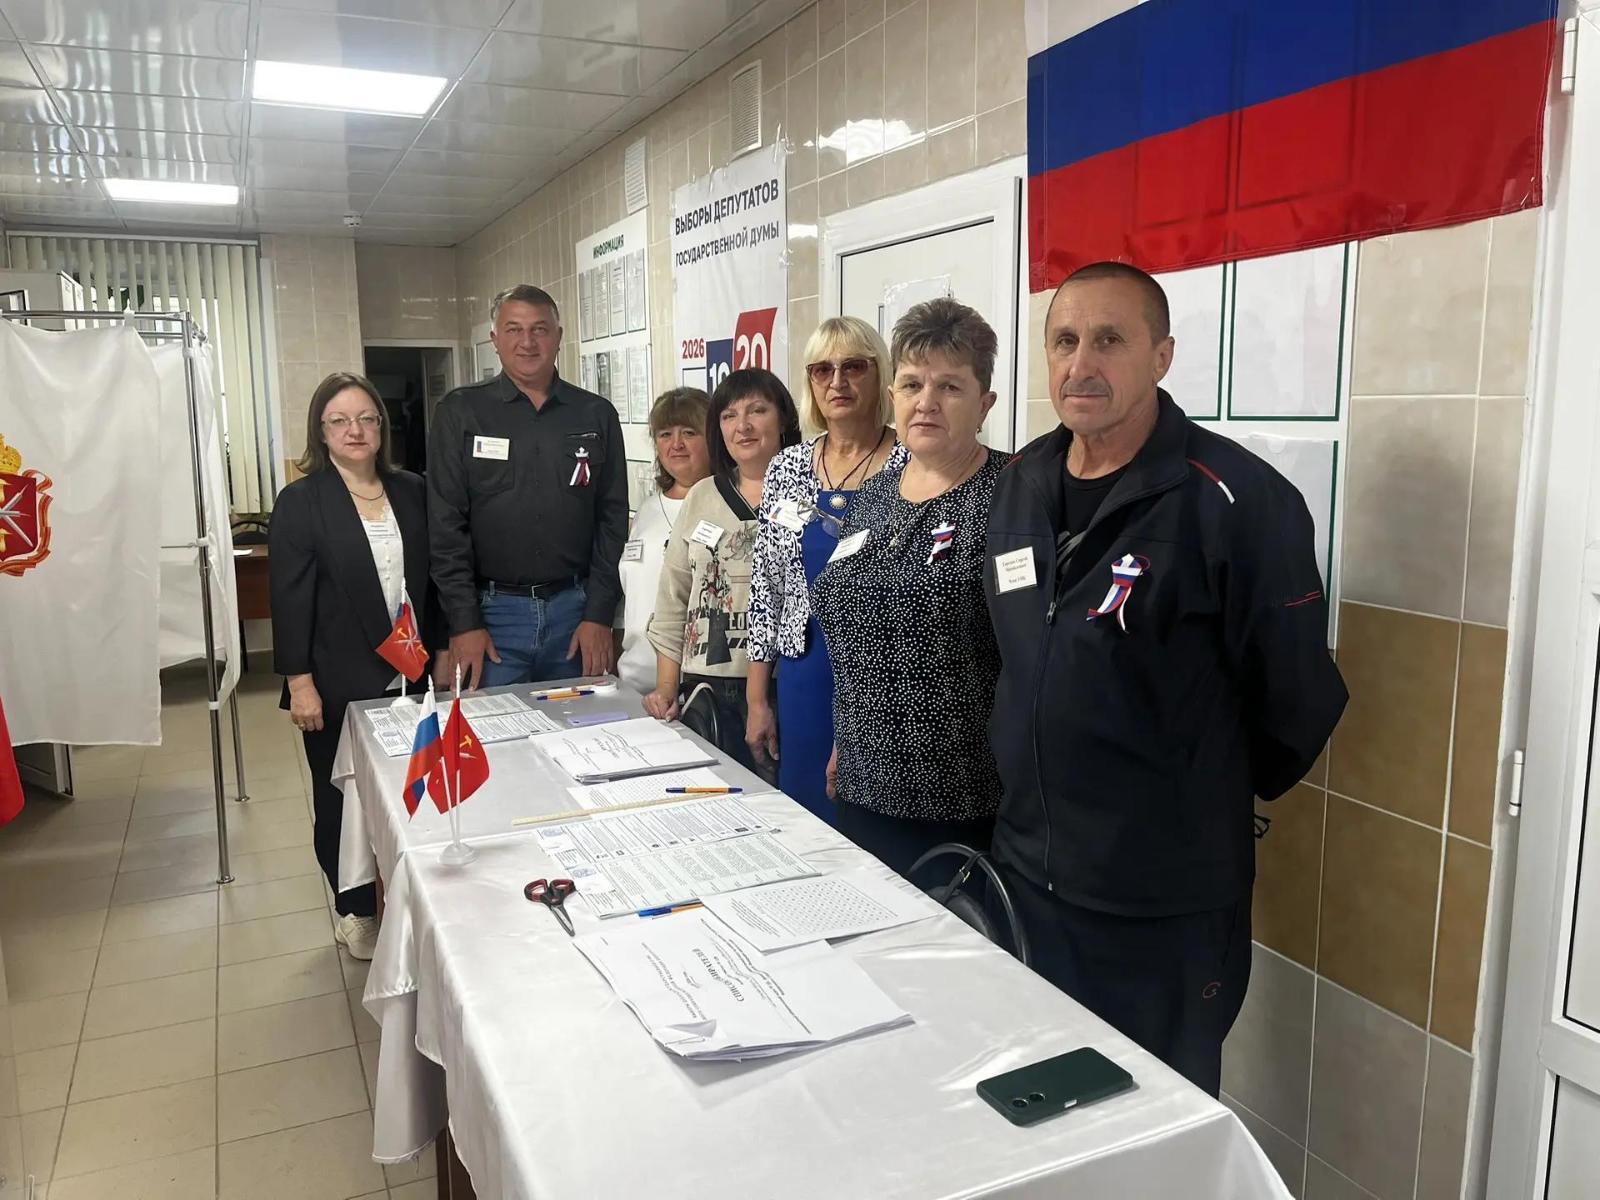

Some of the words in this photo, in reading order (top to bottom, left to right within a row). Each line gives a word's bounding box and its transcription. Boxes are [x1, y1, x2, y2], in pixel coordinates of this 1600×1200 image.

[675, 203, 712, 236] ВЫБОРЫ
[713, 178, 779, 225] ДЕПУТАТОВ
[593, 233, 624, 259] ИНФОРМАЦИЯ
[675, 226, 748, 267] ГОСУДАРСТВЕННОЙ
[749, 220, 779, 248] ДУМЫ
[682, 337, 704, 359] 2026
[736, 332, 768, 371] 20
